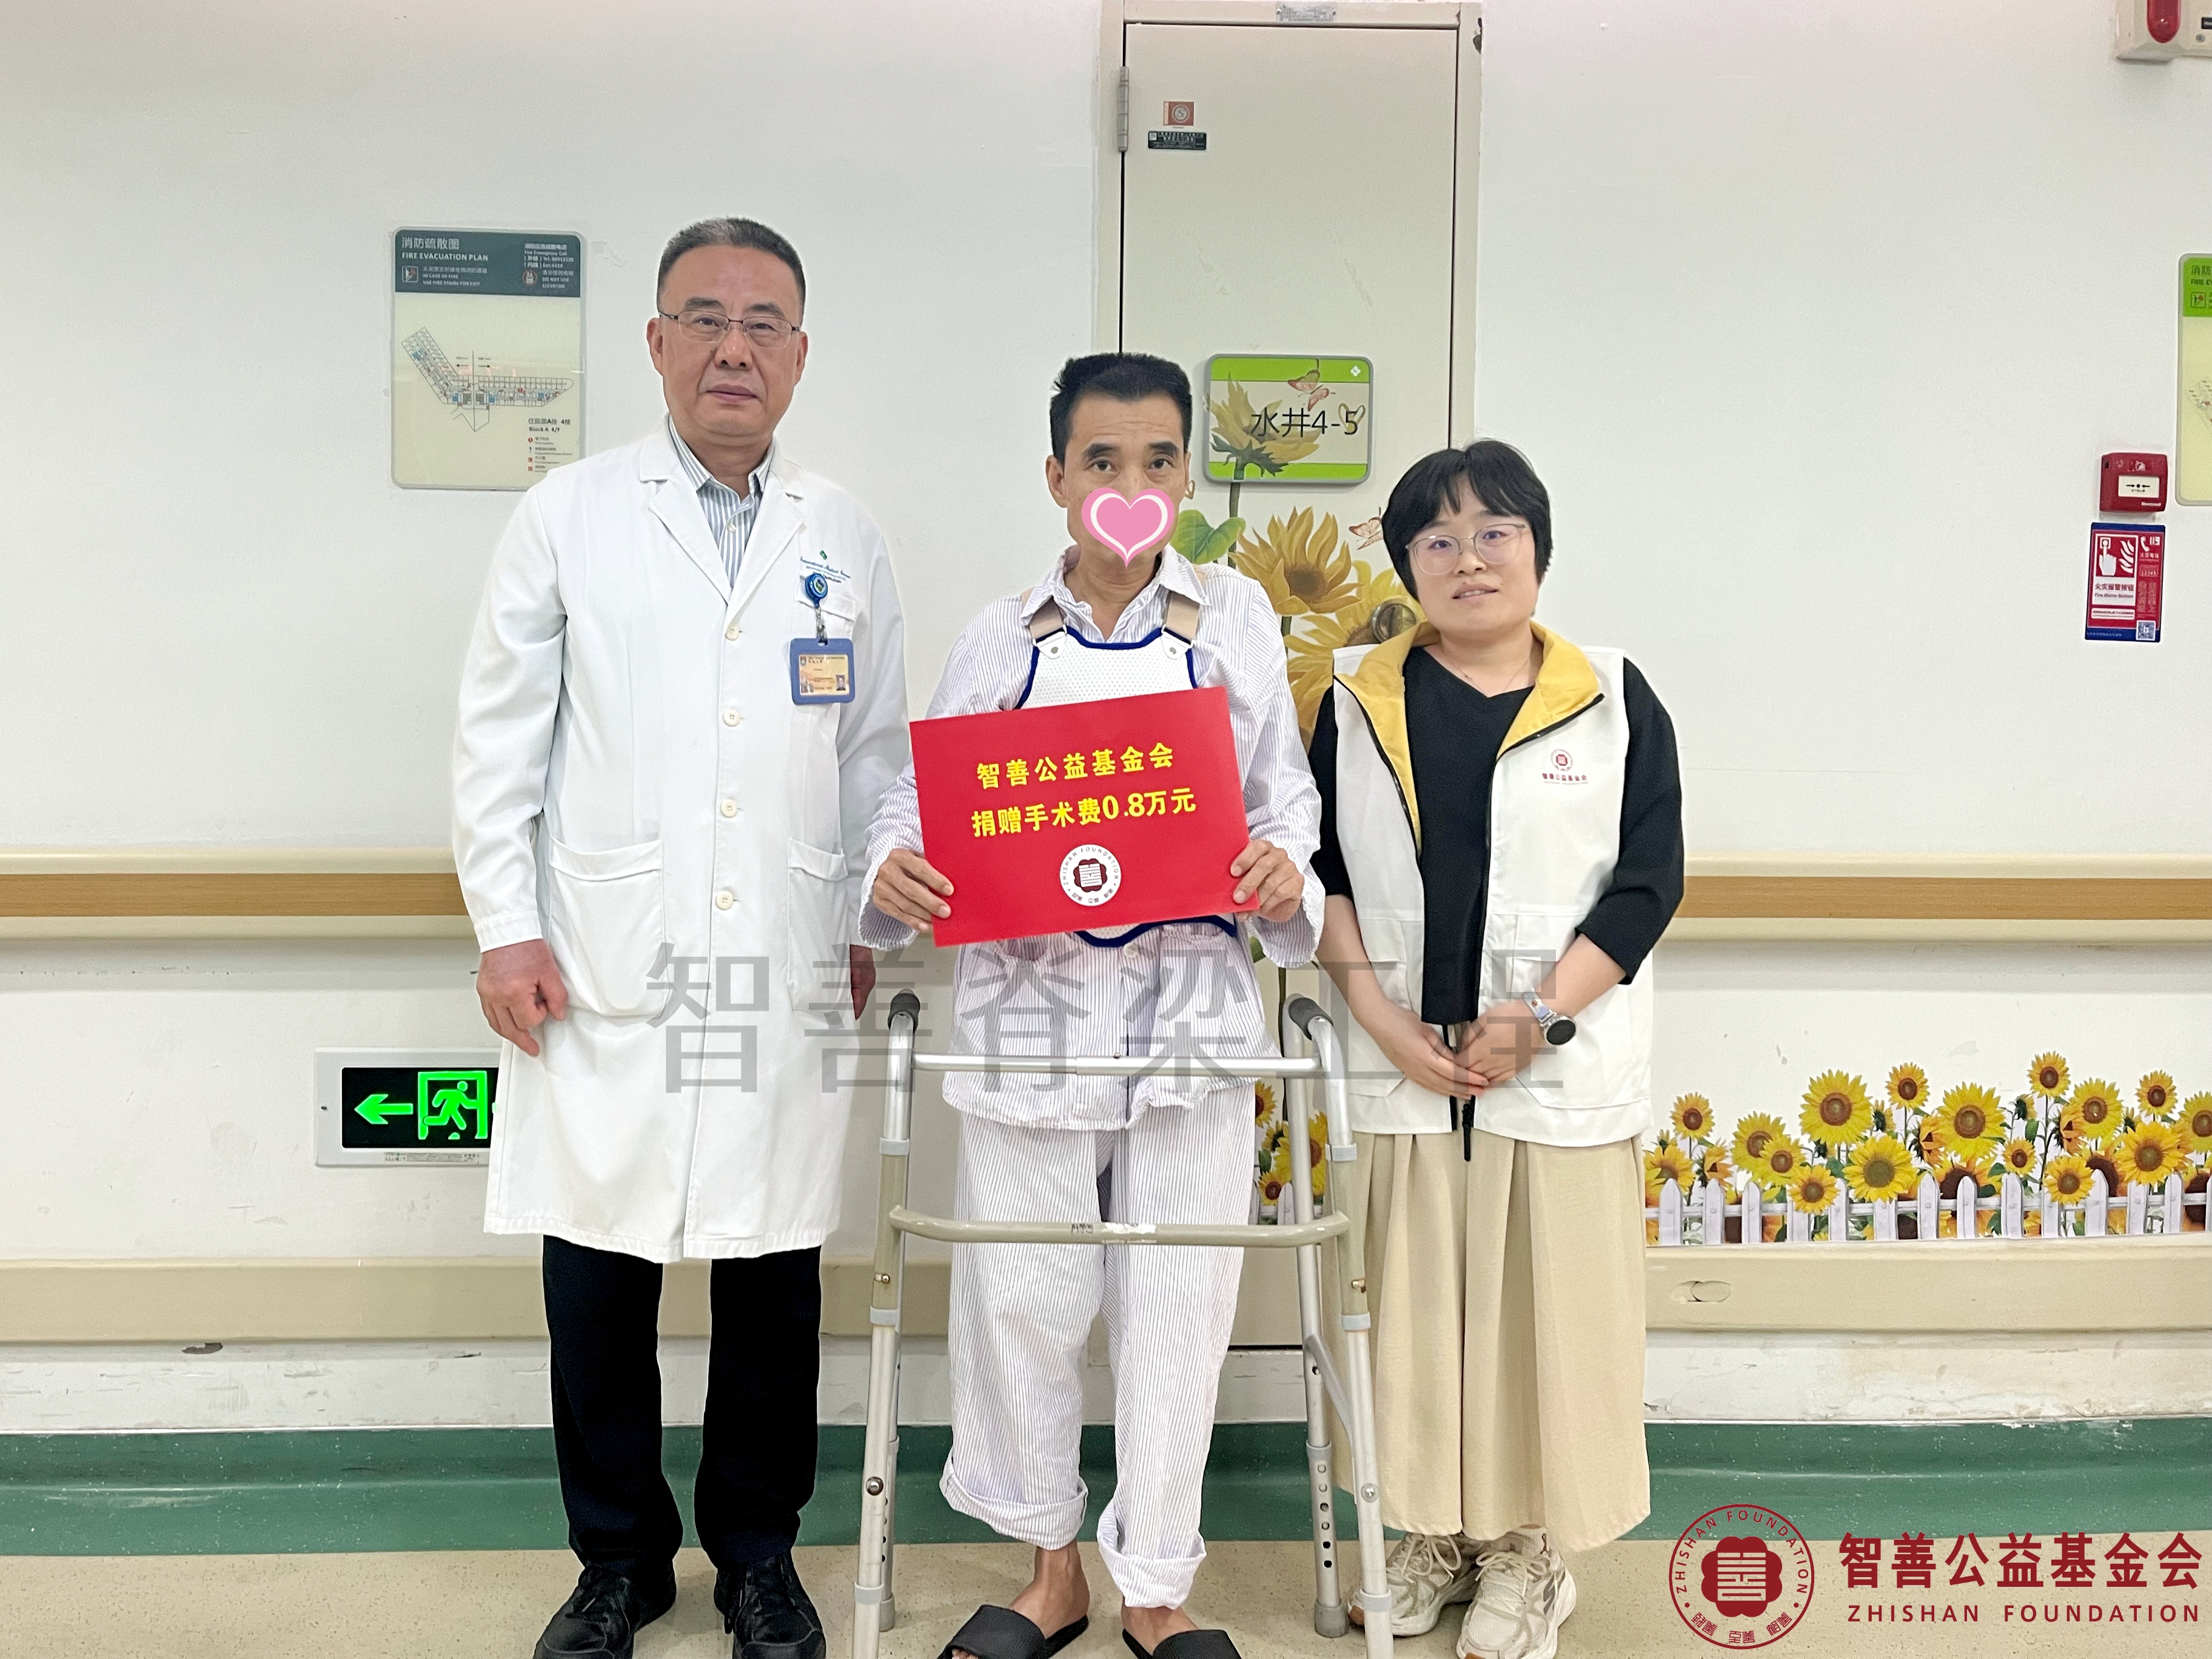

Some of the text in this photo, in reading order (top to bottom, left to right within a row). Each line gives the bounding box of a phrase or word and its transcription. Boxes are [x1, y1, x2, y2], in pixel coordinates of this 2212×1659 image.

[419, 252, 468, 261] EVACUATION
[1251, 407, 1358, 438] 水井4-5
[977, 742, 1173, 789] 智善公益基金会
[971, 787, 1196, 837] 捐赠手术费0.8万元
